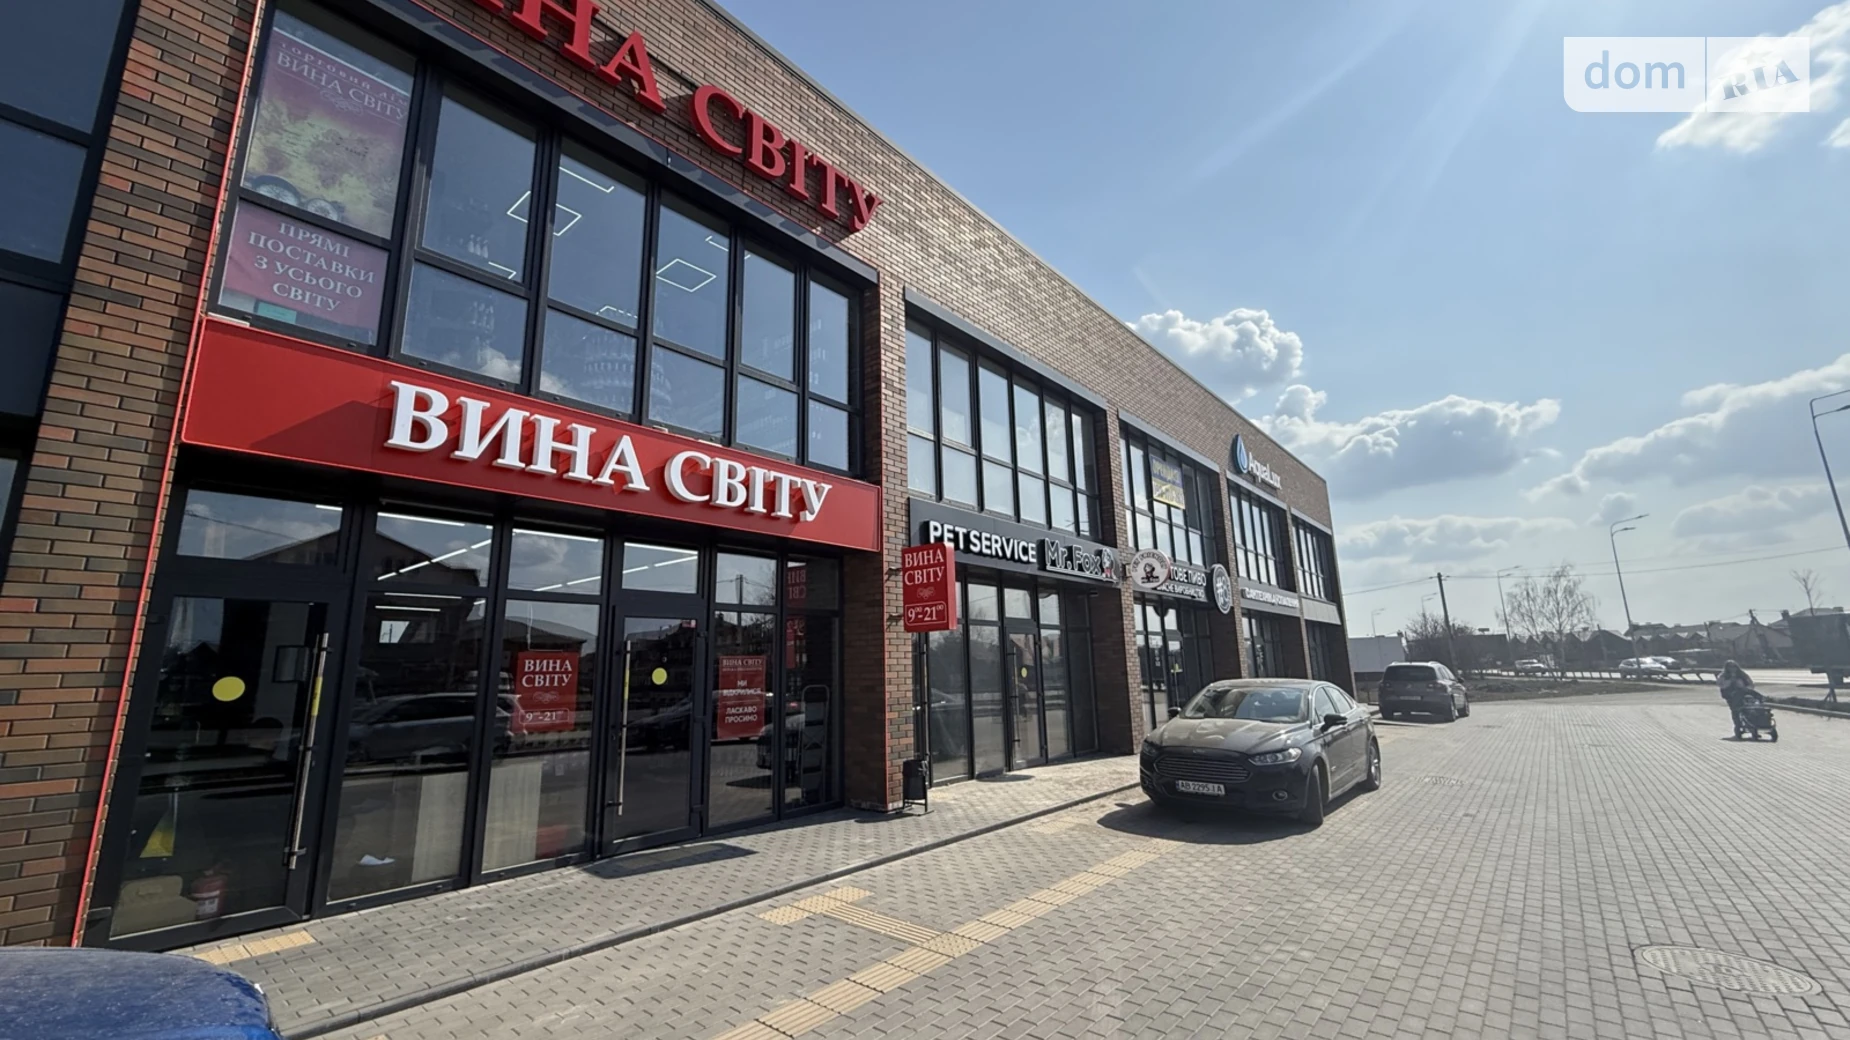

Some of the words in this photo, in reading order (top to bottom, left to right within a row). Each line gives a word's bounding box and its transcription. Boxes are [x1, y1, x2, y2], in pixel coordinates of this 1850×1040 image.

[277, 52, 343, 95] ВИНА
[349, 88, 407, 119] СВІТУ
[472, 0, 666, 114] НА
[690, 84, 883, 232] СВІТУ
[279, 222, 350, 258] ПРЯМІ
[248, 231, 376, 283] ПОСТАВКИ
[274, 261, 363, 299] УСЬОГО
[273, 283, 341, 311] СВІТУ
[384, 380, 650, 492] ВИНА
[664, 450, 832, 522] СВІТУ
[929, 520, 967, 549] PET
[969, 530, 1037, 563] SERVICE
[904, 548, 944, 568] ВИНА
[904, 566, 945, 586] СВІТУ
[521, 674, 573, 688] СВІТУ
[524, 659, 573, 672] ВИНА
[725, 715, 758, 723] ПРОСИМО
[726, 706, 757, 715] ЛАСКАВО
